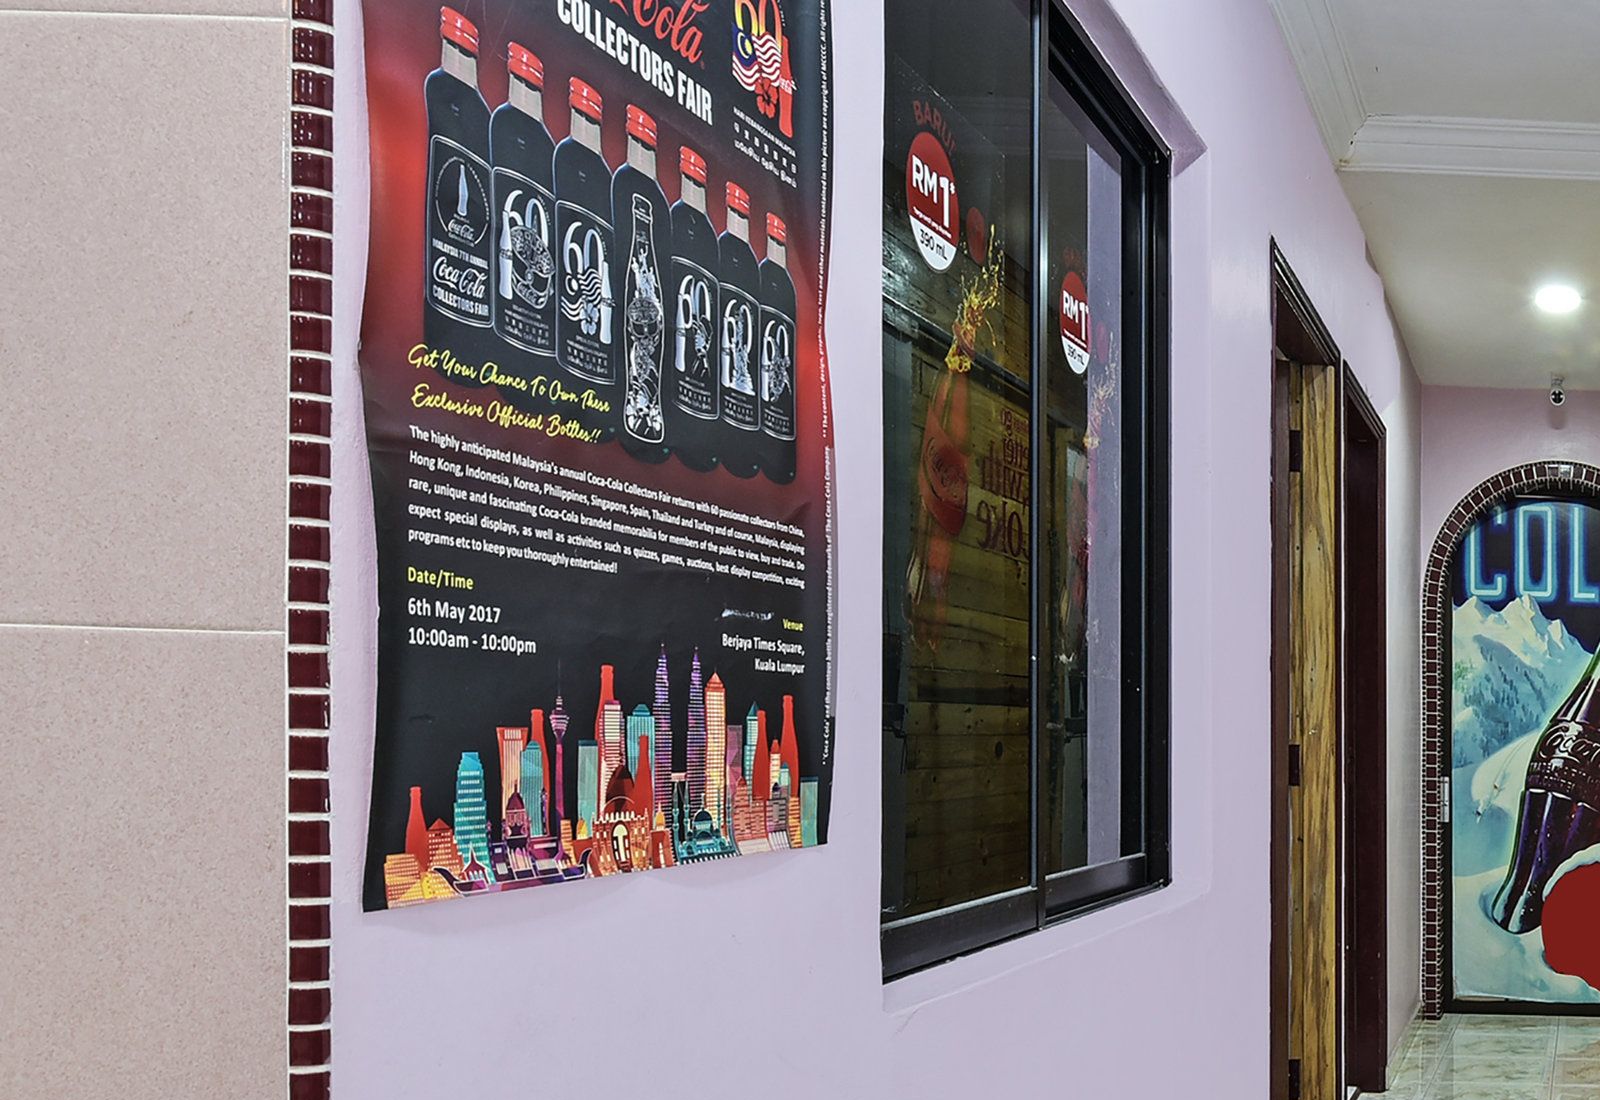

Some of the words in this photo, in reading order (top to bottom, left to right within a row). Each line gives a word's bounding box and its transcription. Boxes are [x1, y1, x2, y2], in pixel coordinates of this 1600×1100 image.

[557, 0, 674, 97] COLLECTORS
[678, 70, 713, 126] FAIR
[920, 229, 935, 251] 390
[936, 243, 948, 261] mL
[433, 256, 488, 299] Coca-Cola
[432, 284, 475, 315] COLLECTORS
[474, 301, 490, 317] FAIR
[408, 344, 440, 368] Get
[440, 350, 478, 379] Your
[479, 362, 528, 392] Chance
[530, 376, 547, 397] To
[549, 380, 579, 403] Own
[581, 389, 611, 413] These
[411, 383, 484, 418] Exclusive
[487, 400, 544, 431] Official
[546, 414, 602, 444] Bottles!!
[409, 425, 430, 442] The
[431, 430, 460, 451] highly
[462, 441, 510, 463] anticipated
[512, 453, 558, 474] Malaysia's
[560, 465, 586, 482] annual
[587, 472, 622, 491] Coca-Cola
[624, 482, 658, 500] Collectors
[659, 490, 671, 503] Fair
[672, 496, 695, 510] returns
[696, 501, 710, 513] with
[711, 504, 719, 515] 60
[750, 515, 776, 530] collectors
[776, 520, 788, 532] from
[409, 450, 435, 471] Hong
[437, 458, 464, 477] Kong,
[466, 465, 512, 488] Indonesia,
[514, 476, 542, 495] Korea,
[544, 484, 590, 506] Philippines,
[590, 494, 629, 515] Singapore,
[630, 504, 651, 520] Spain,
[652, 509, 680, 525] Thailand
[681, 518, 693, 528] and
[694, 519, 714, 535] Turkey
[715, 525, 726, 536] and
[727, 527, 734, 537] of
[734, 532, 754, 544] course,
[408, 478, 432, 494] rare,
[434, 484, 468, 500] unique
[469, 491, 487, 505] and
[489, 494, 538, 517] fascinating
[538, 505, 579, 523] Coca-Cola
[580, 513, 612, 531] branded
[613, 522, 656, 540] memorabilia
[658, 530, 668, 542] for
[669, 535, 699, 549] members
[700, 540, 706, 550] of
[708, 541, 718, 552] the
[719, 545, 737, 557] public
[738, 549, 744, 558] to
[746, 550, 760, 562] view,
[761, 552, 770, 564] buy
[772, 556, 780, 566] and
[796, 561, 805, 570] Do
[408, 503, 441, 520] expect
[444, 510, 478, 526] special
[480, 516, 520, 536] displays,
[522, 526, 532, 536] as
[535, 528, 552, 542] well
[556, 532, 564, 542] as
[567, 534, 602, 550] activities
[604, 541, 621, 553] such
[623, 546, 632, 555] as
[633, 547, 660, 562] quizzes,
[662, 554, 685, 566] games,
[686, 558, 714, 572] auctions,
[716, 561, 729, 574] best
[730, 565, 751, 578] display
[786, 577, 805, 590] exciting
[408, 529, 454, 546] programs
[456, 536, 470, 548] etc
[472, 538, 482, 550] to
[483, 540, 505, 556] keep
[506, 546, 522, 558] you
[524, 547, 570, 568] thoroughly
[570, 556, 618, 574] entertained!
[408, 566, 474, 590] Date/Time
[408, 598, 431, 616] 6th
[435, 600, 465, 624] May
[468, 604, 500, 624] 2017
[783, 619, 804, 632] Venue
[408, 627, 469, 648] 10:00am
[481, 634, 536, 656] 10:00pm
[722, 634, 752, 651] Berjaya
[753, 637, 776, 652] Times
[777, 640, 805, 656] Square,
[755, 658, 776, 672] Kuala
[777, 660, 805, 676] Lumpur
